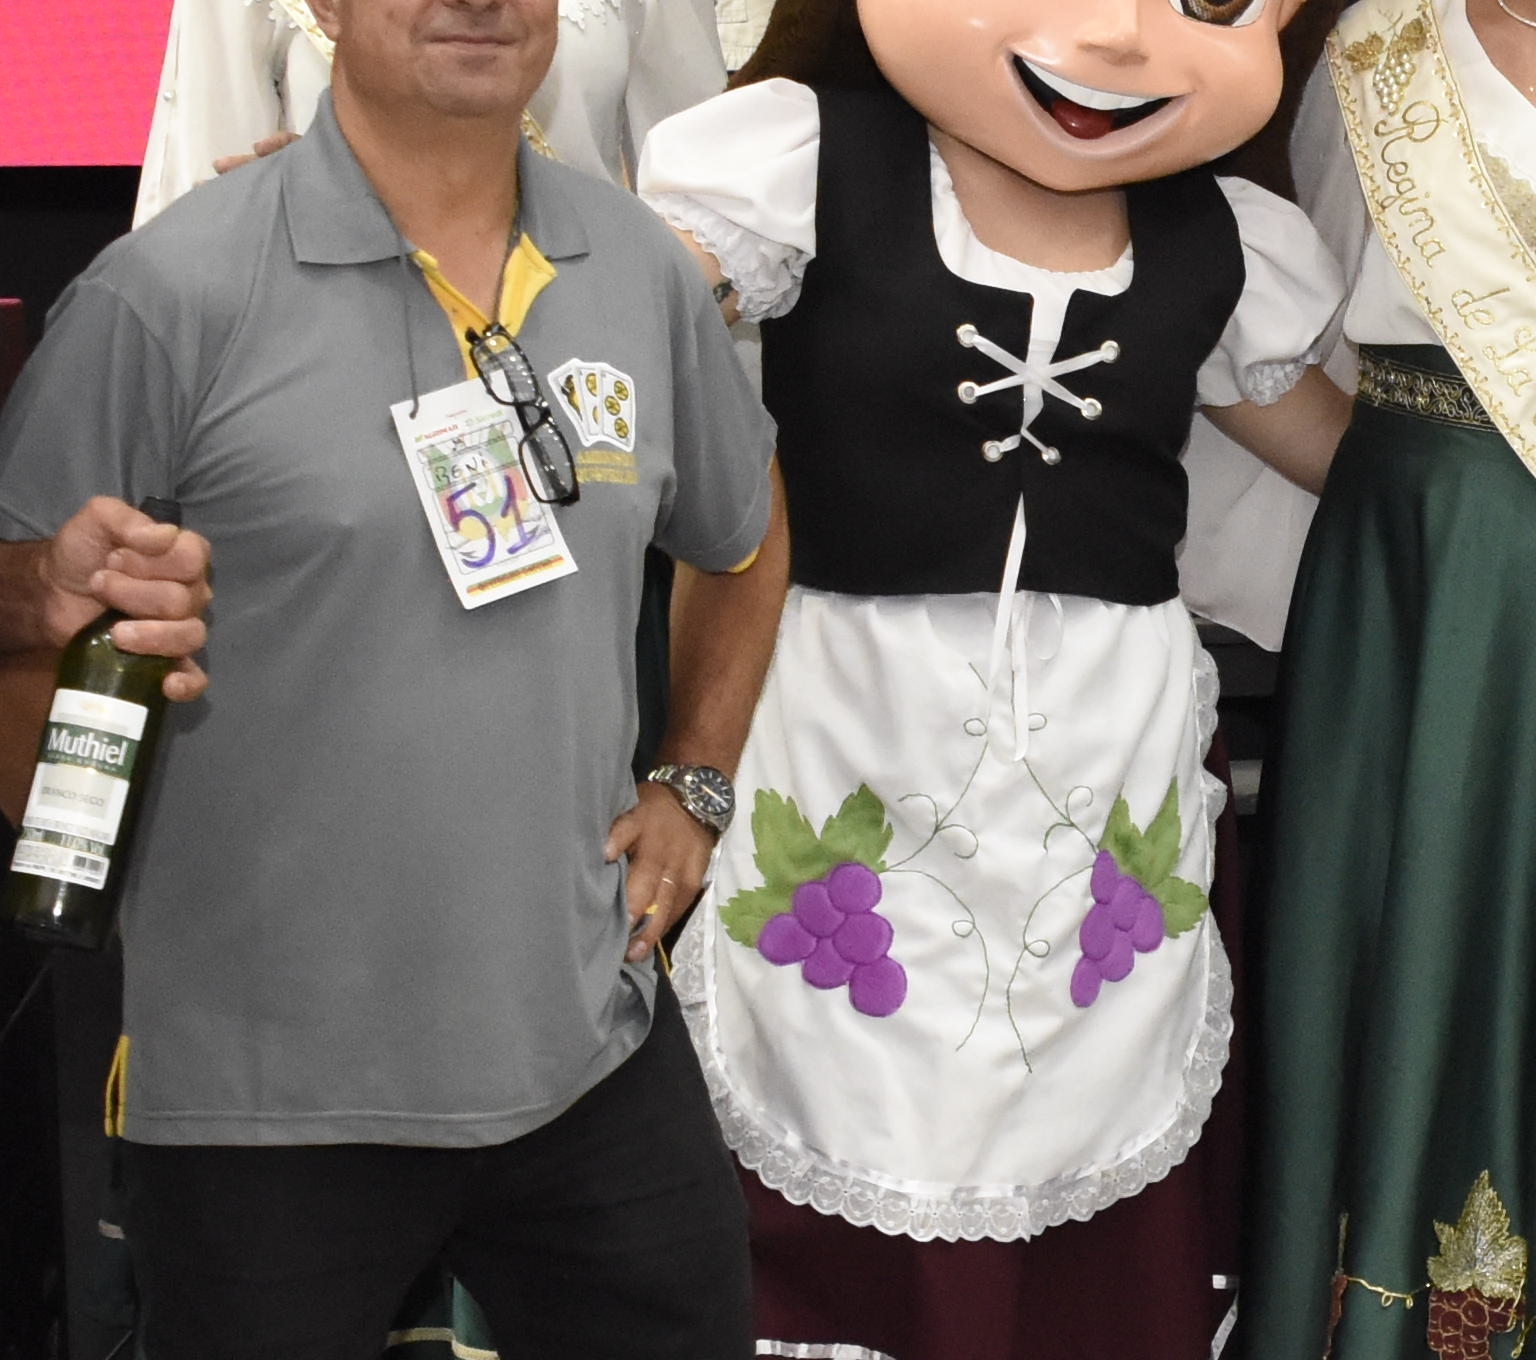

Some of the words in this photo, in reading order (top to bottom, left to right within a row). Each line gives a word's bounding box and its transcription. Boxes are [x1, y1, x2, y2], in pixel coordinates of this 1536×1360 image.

[1374, 100, 1448, 269] Regina
[1451, 287, 1511, 330] de
[445, 474, 537, 569] 51
[48, 728, 128, 766] Muthiel
